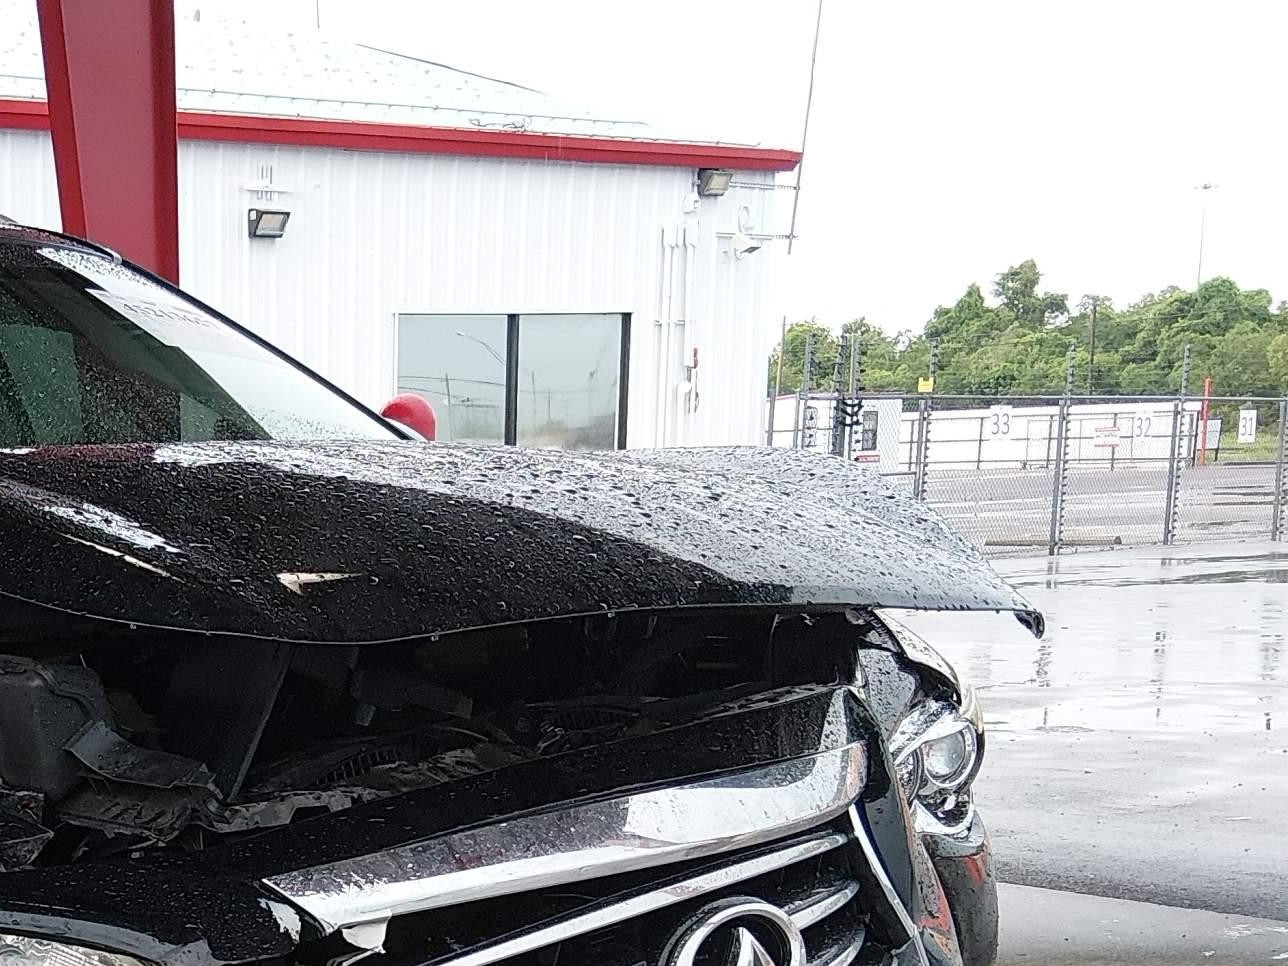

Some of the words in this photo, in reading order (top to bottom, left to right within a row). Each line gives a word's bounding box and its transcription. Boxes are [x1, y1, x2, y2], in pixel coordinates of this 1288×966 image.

[991, 412, 1011, 436] 33
[1135, 416, 1152, 438] 32
[1240, 416, 1255, 437] 31
